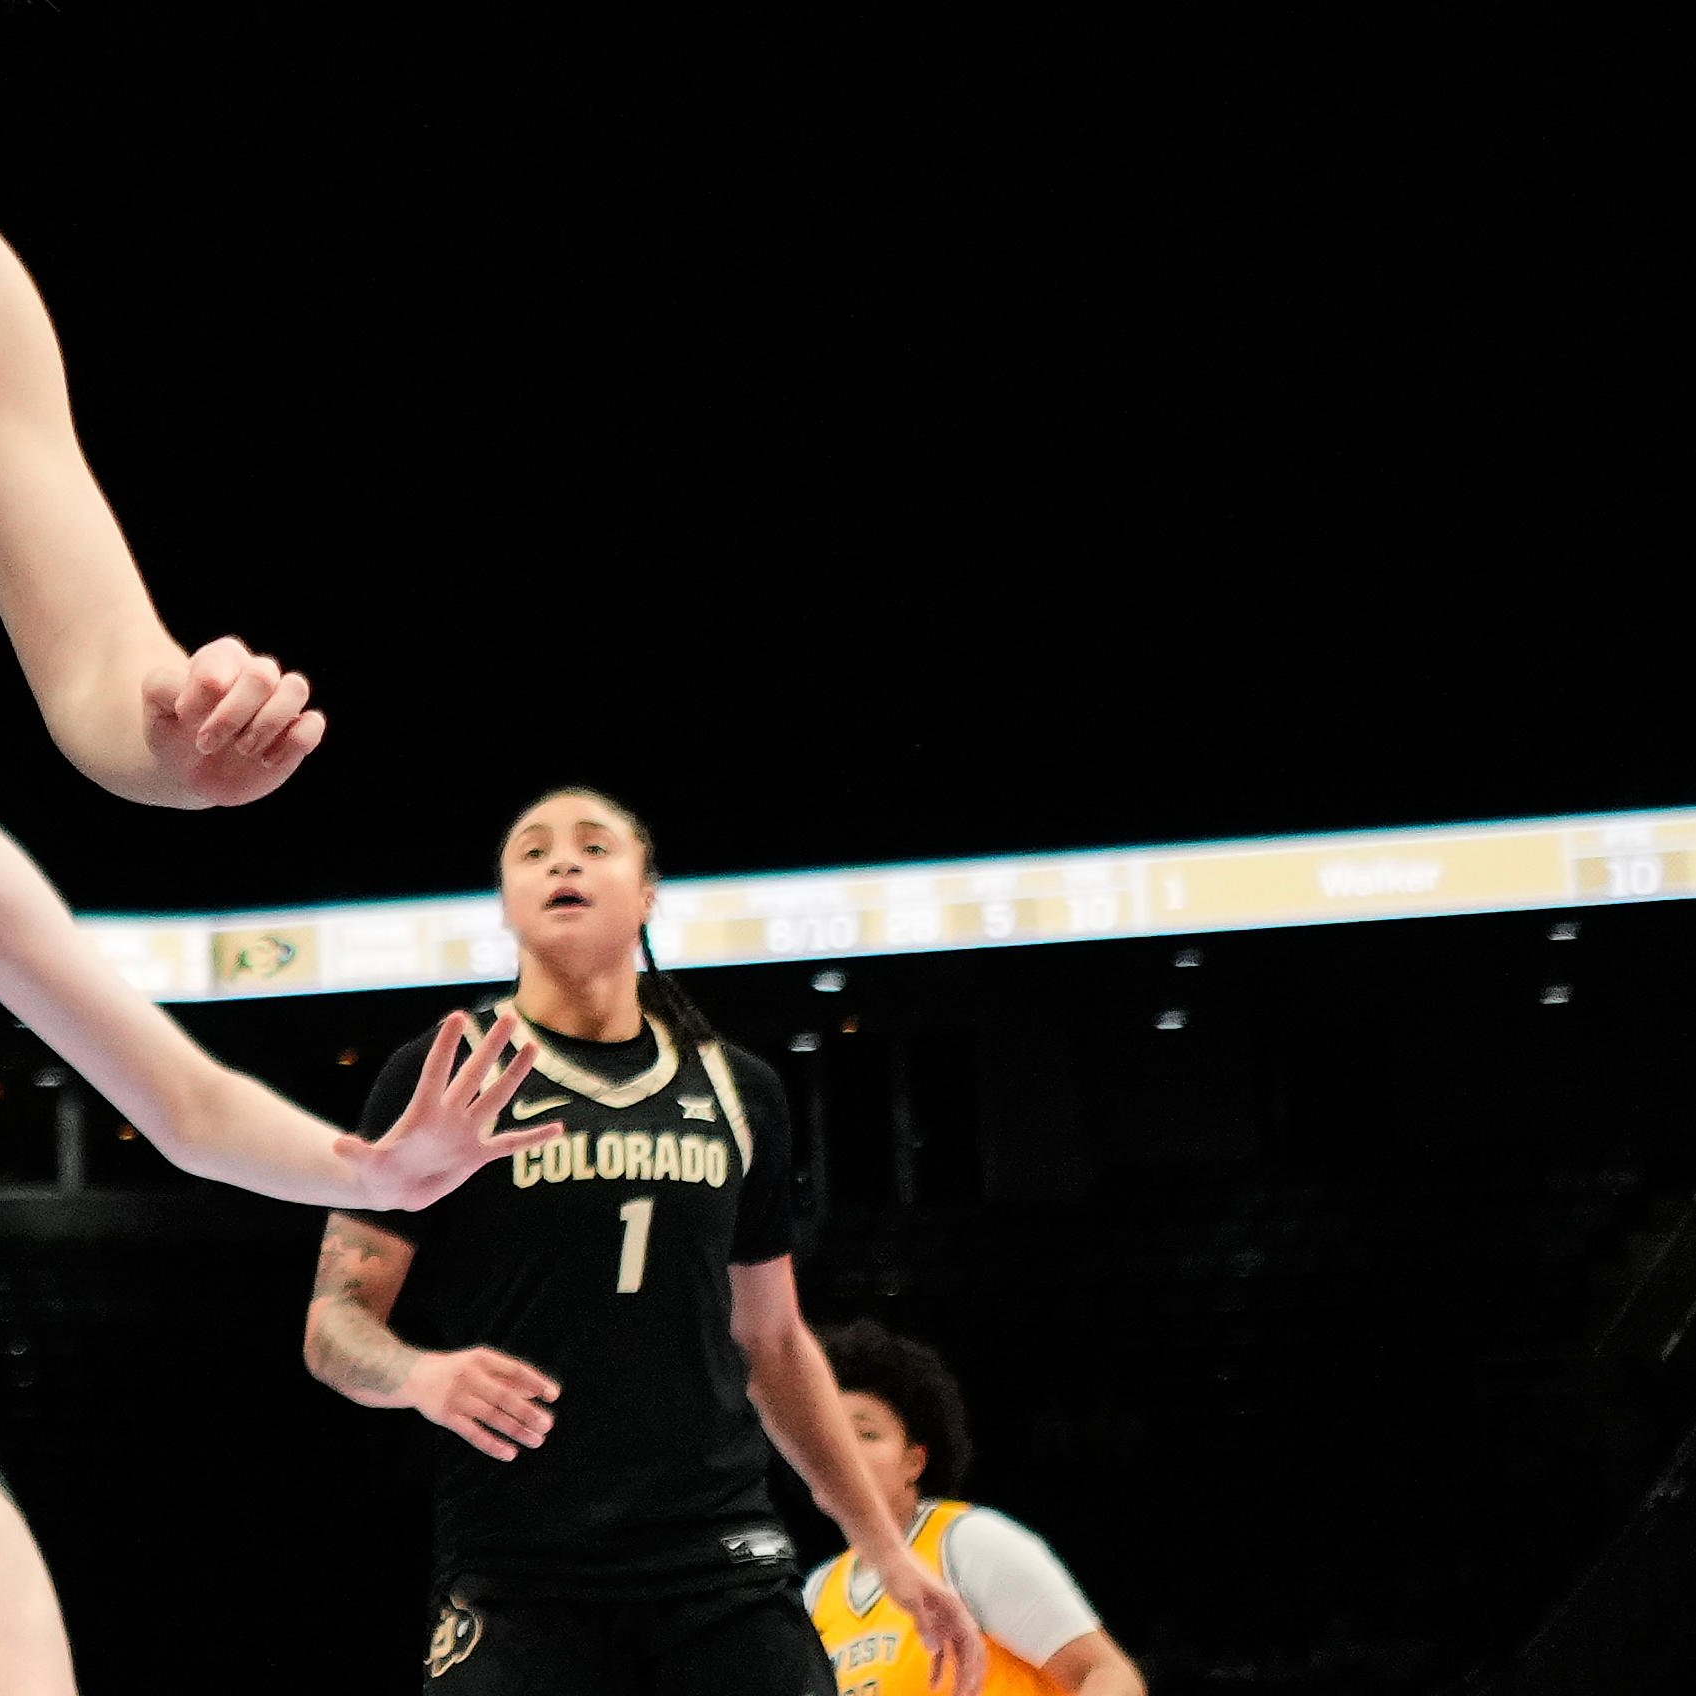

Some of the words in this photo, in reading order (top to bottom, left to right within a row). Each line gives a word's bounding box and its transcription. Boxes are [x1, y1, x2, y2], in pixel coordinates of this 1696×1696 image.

[1318, 858, 1443, 899] Walker
[512, 1132, 728, 1189] COLORADO
[616, 1198, 654, 1294] 1
[833, 1633, 900, 1670] EST
